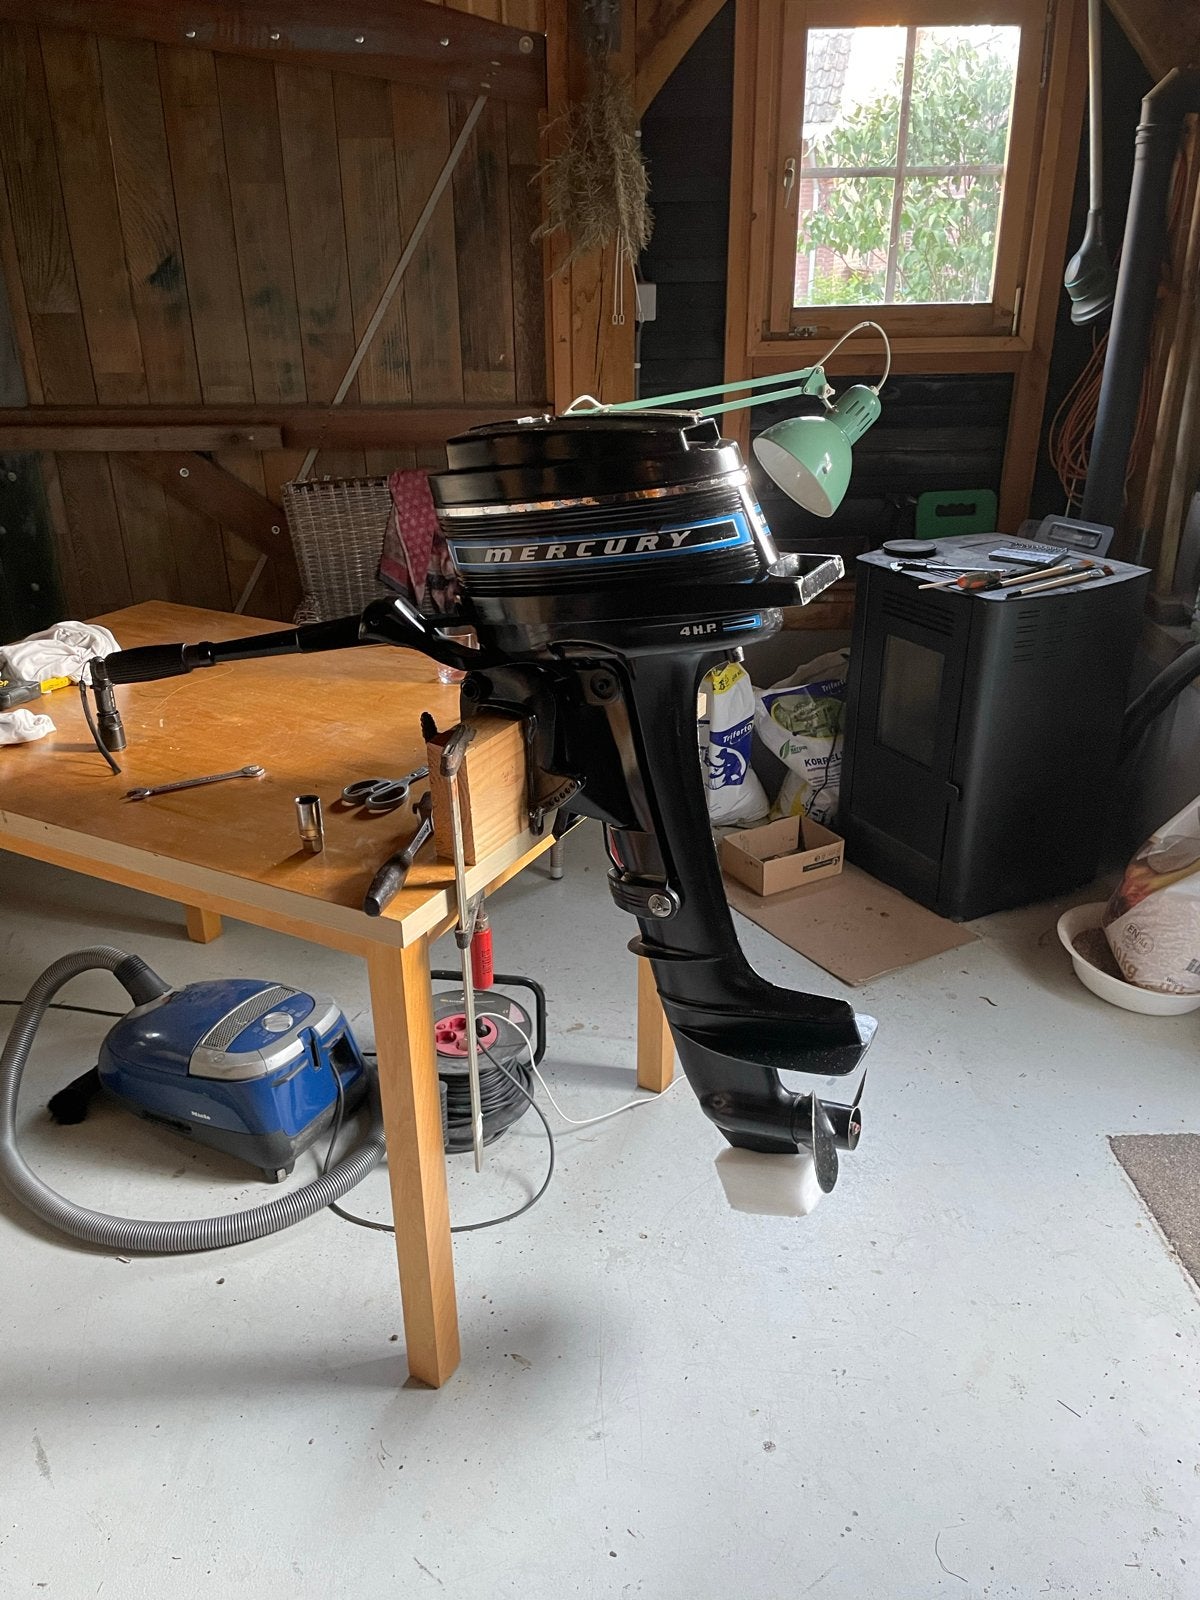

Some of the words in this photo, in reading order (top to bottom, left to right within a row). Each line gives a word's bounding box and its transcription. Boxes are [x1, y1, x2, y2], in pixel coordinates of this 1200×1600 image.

[484, 530, 691, 562] MERCURY
[679, 626, 691, 636] 4
[693, 623, 718, 635] H.P.
[722, 722, 753, 743] Triferto
